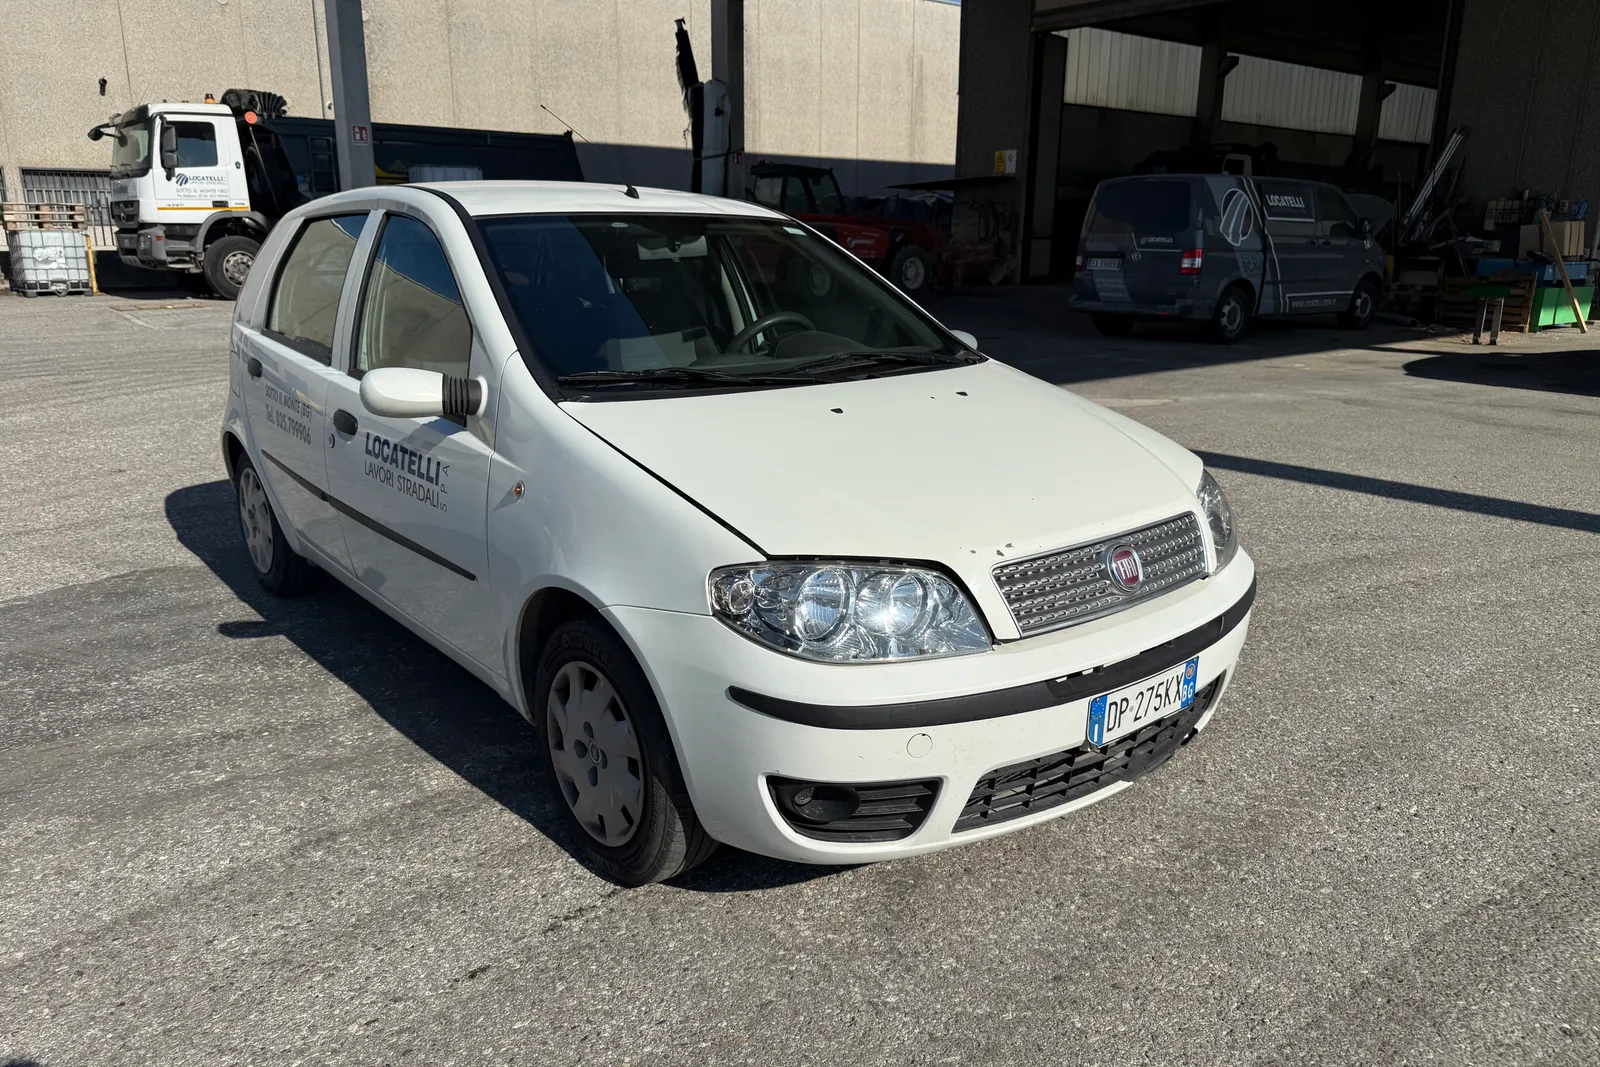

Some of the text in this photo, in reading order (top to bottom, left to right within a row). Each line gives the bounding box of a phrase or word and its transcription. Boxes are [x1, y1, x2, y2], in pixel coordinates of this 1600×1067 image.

[1265, 194, 1306, 208] LOCATELLI
[265, 384, 279, 403] SOTTO
[283, 393, 301, 414] MONTE
[300, 402, 313, 423] (BG)
[275, 409, 312, 446] 035.799906
[364, 431, 441, 487] LOCATELLI
[364, 457, 440, 509] LAVORI STRADALI
[1116, 556, 1138, 580] FIAT
[1181, 681, 1195, 702] BG
